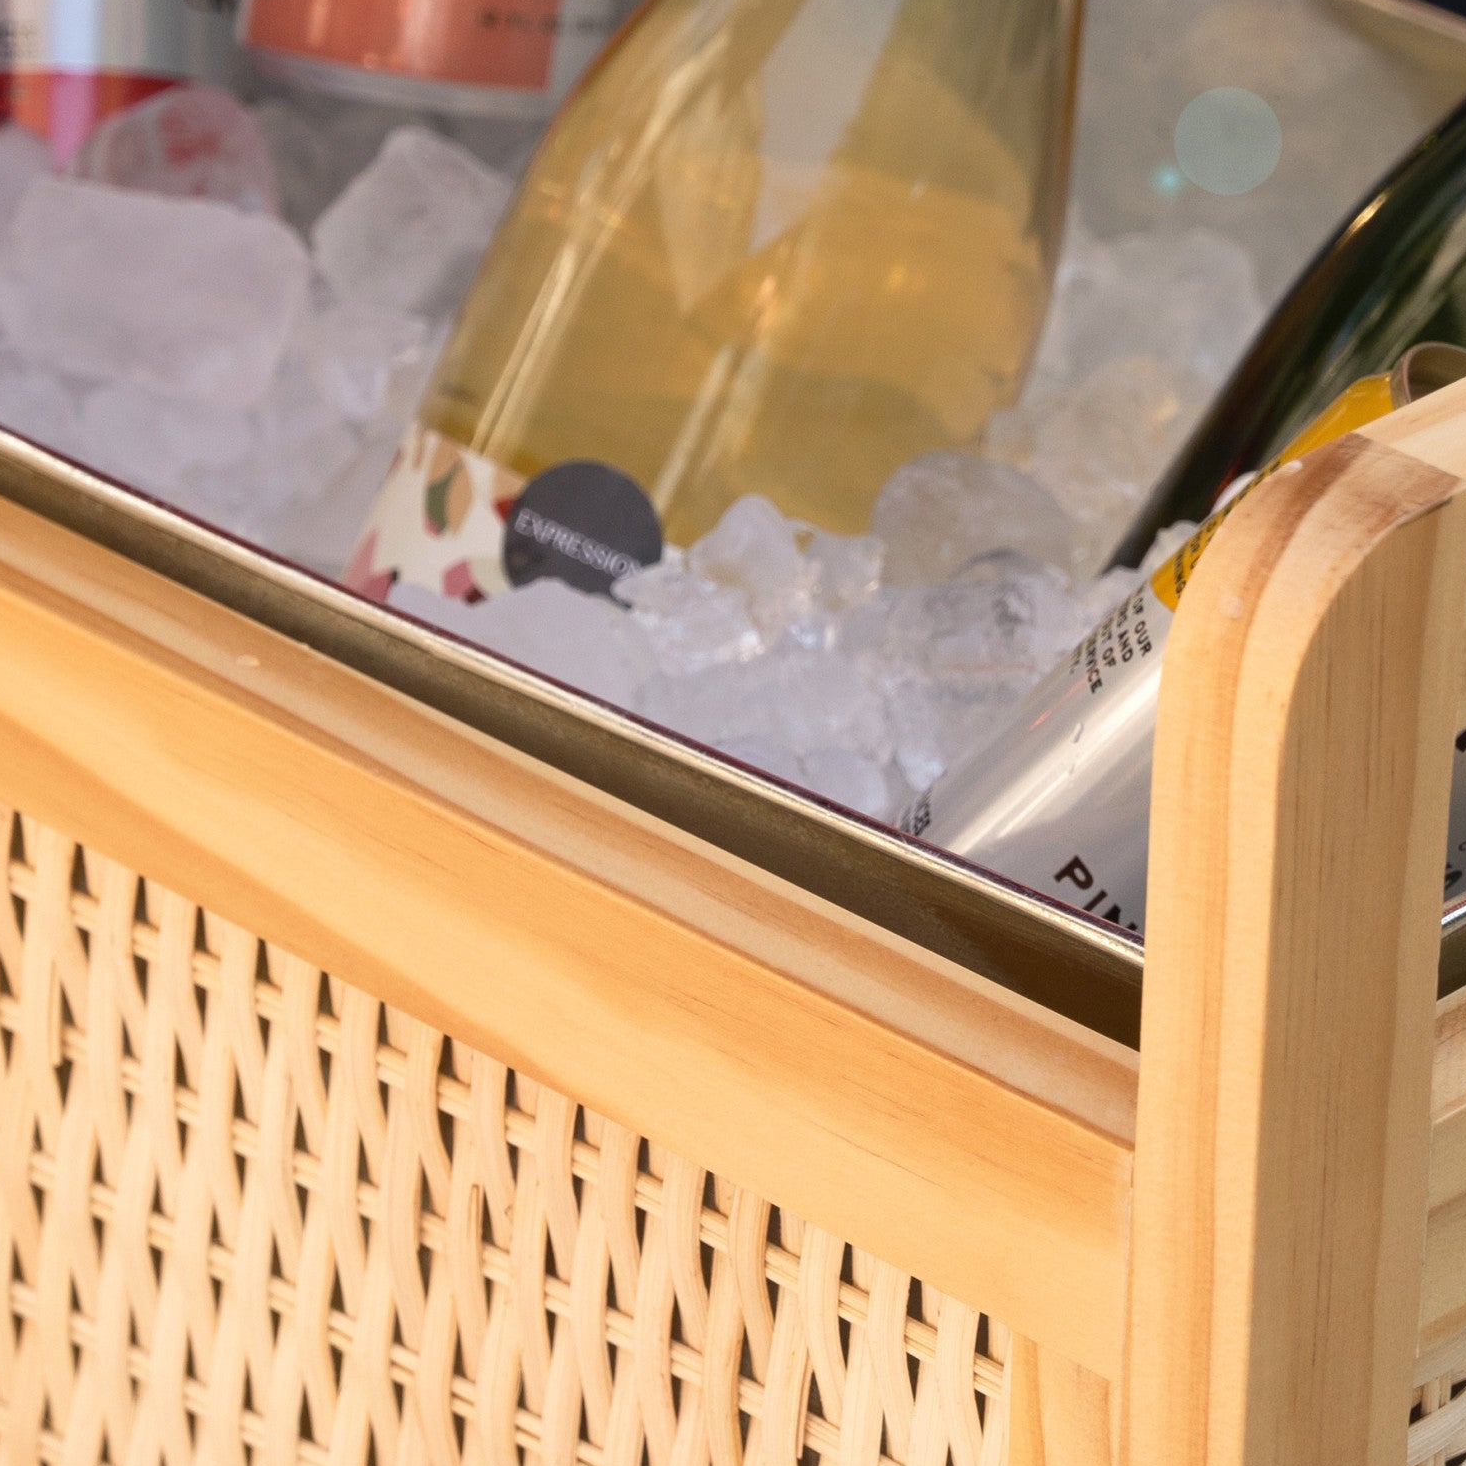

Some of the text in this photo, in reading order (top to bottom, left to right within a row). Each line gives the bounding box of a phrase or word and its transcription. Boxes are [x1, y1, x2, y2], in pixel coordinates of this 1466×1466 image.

[1117, 629, 1134, 663] AND
[1134, 620, 1152, 657] OUR
[1102, 647, 1117, 668] OF
